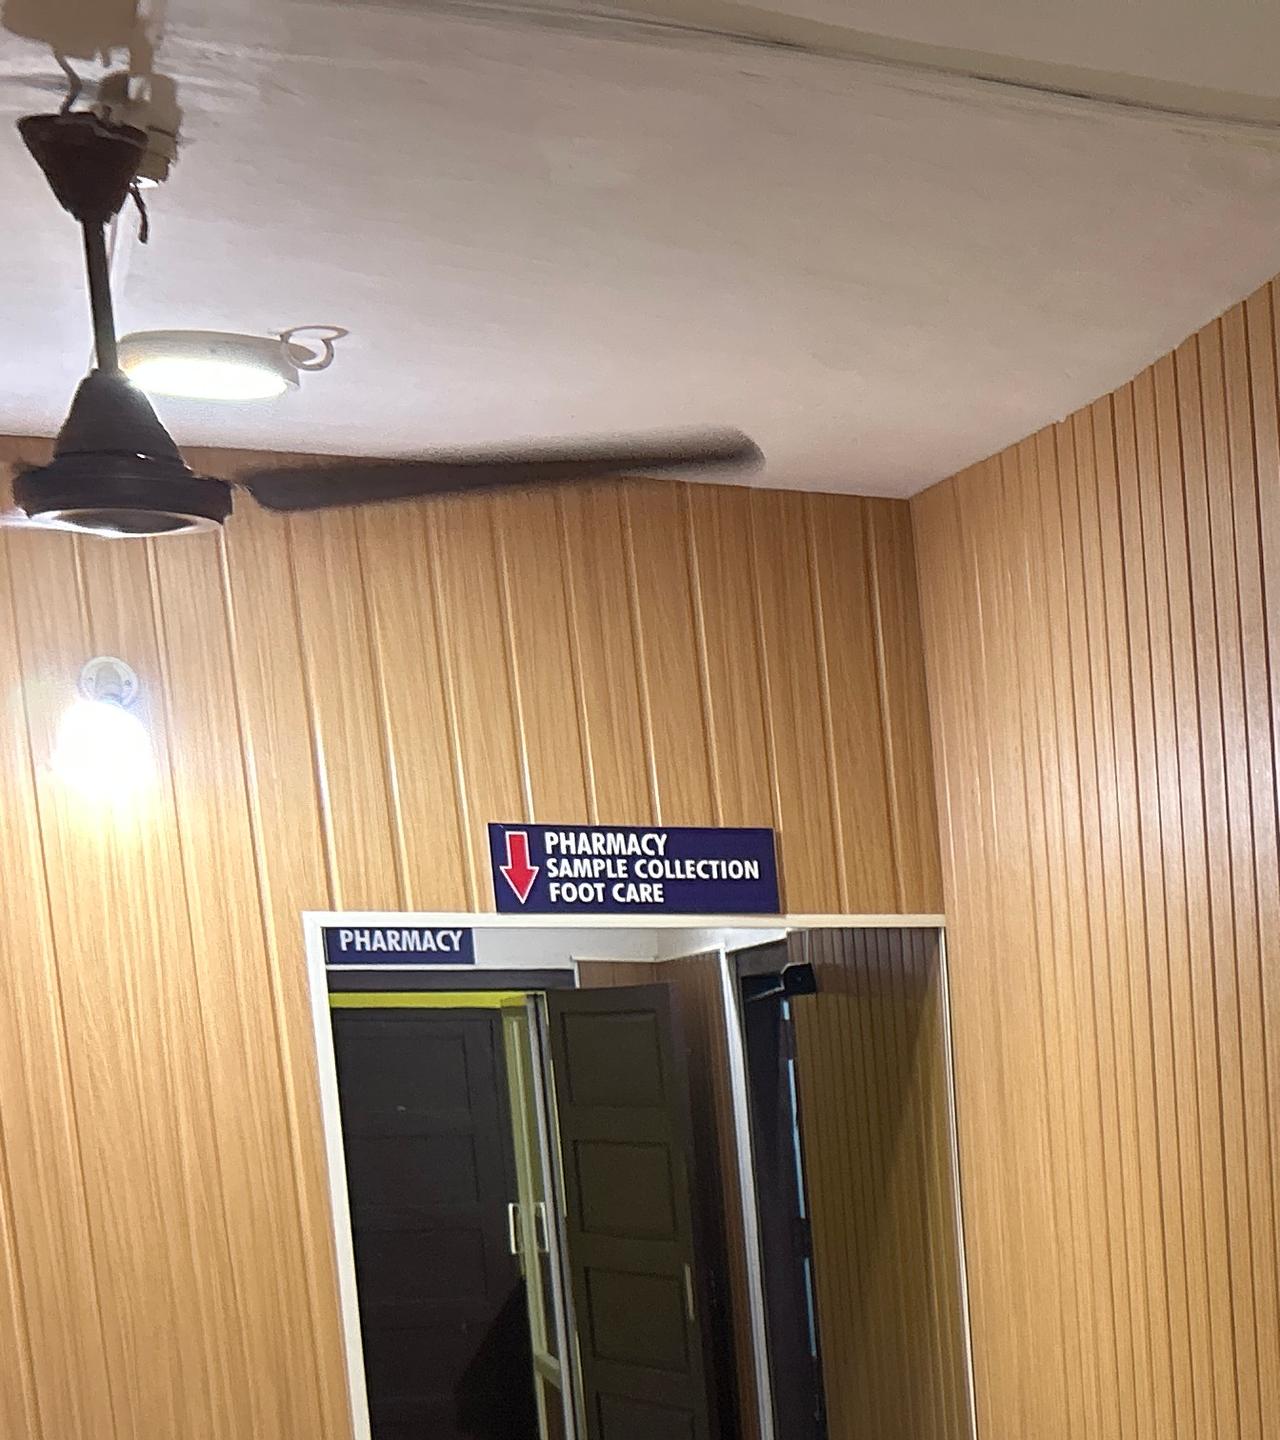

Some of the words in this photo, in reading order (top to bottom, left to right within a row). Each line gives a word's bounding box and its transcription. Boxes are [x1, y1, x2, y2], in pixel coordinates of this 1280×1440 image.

[544, 831, 667, 856] PHARMACY
[547, 857, 627, 880] SAMPLE
[633, 857, 759, 880] COLLECTION
[549, 881, 604, 904] FOOT
[611, 881, 665, 904] CARE
[339, 928, 462, 952] PHARMACY
